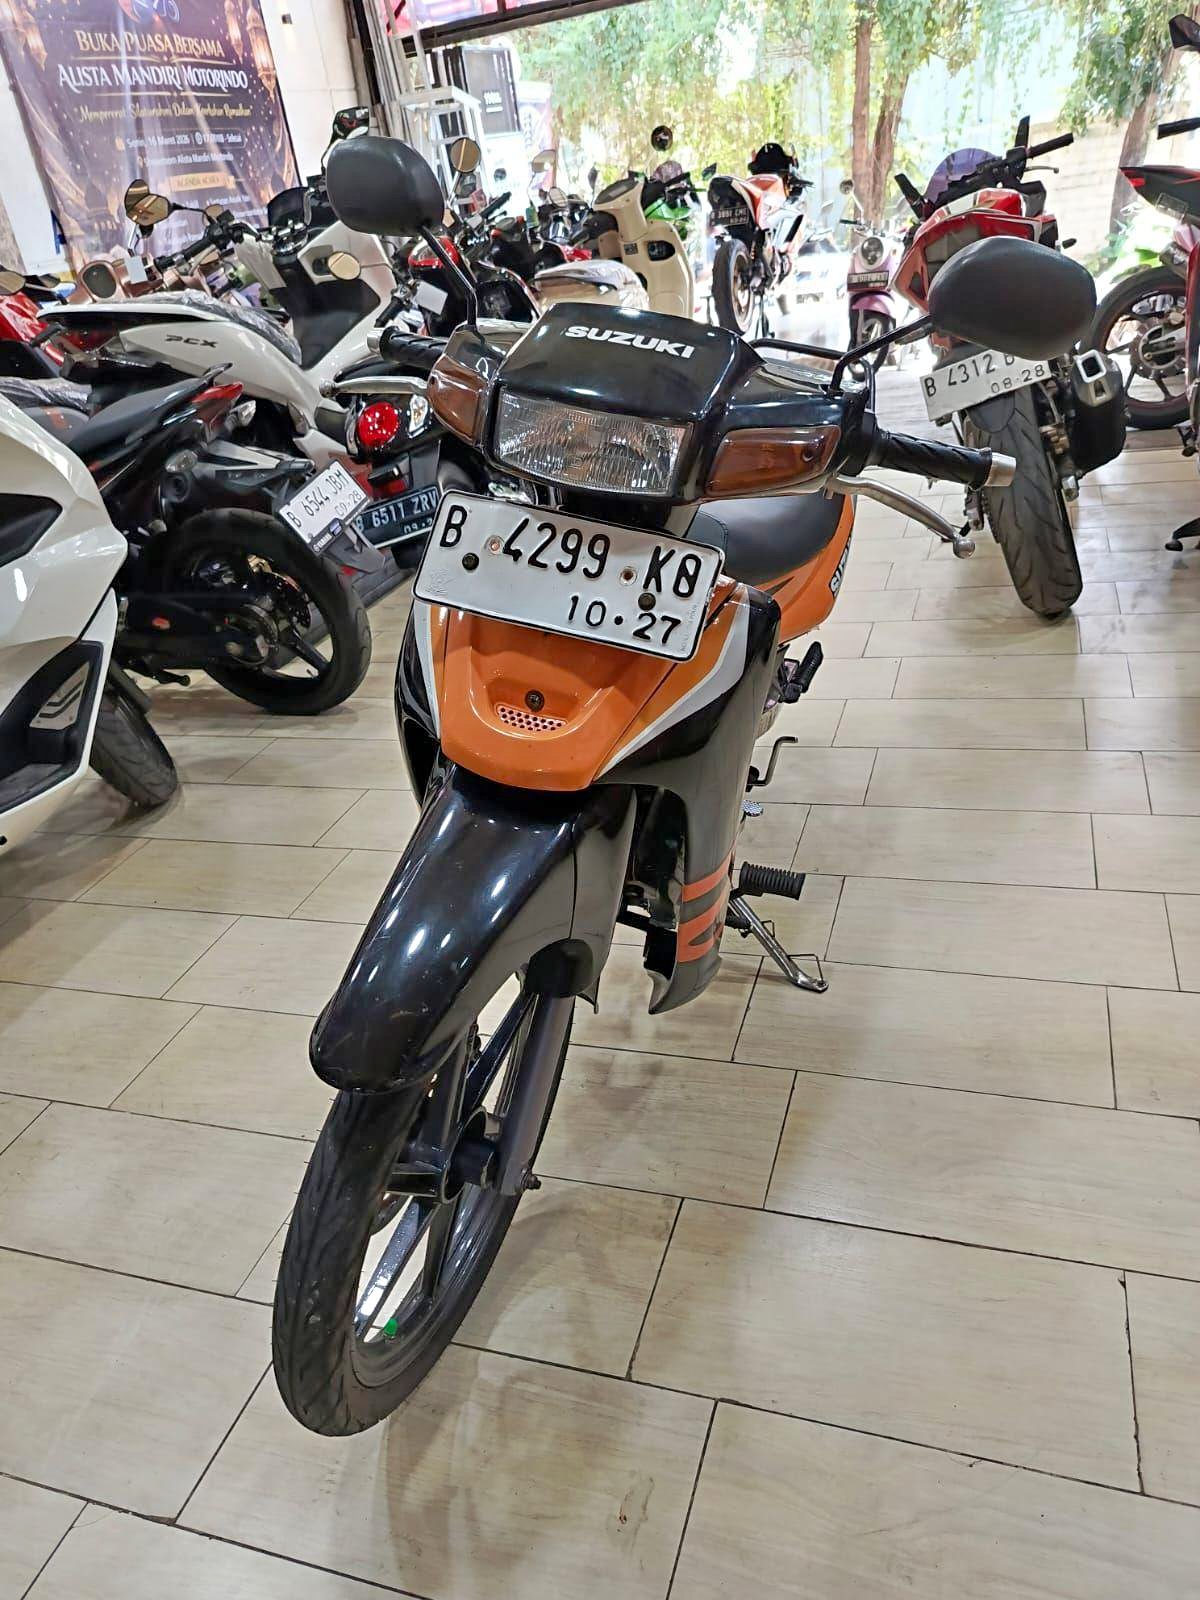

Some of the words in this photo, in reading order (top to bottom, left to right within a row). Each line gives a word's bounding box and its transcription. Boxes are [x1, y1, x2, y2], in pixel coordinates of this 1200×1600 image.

[74, 30, 119, 51] BUKA
[124, 31, 173, 52] PUASA
[173, 34, 225, 57] BERSAMA
[58, 64, 112, 94] ALISTA
[113, 64, 183, 91] MANDIRI
[182, 65, 248, 92] MOTORINDO
[165, 333, 218, 348] PCX
[565, 325, 695, 359] SUZUKI
[924, 377, 937, 397] B
[947, 353, 995, 386] 4312
[286, 512, 302, 528] B
[301, 487, 330, 517] 6544
[325, 469, 349, 495] JBM
[355, 515, 364, 533] B
[372, 502, 405, 528] 6511
[411, 490, 437, 515] ZRV
[440, 504, 467, 547] B
[503, 517, 611, 579] 4299
